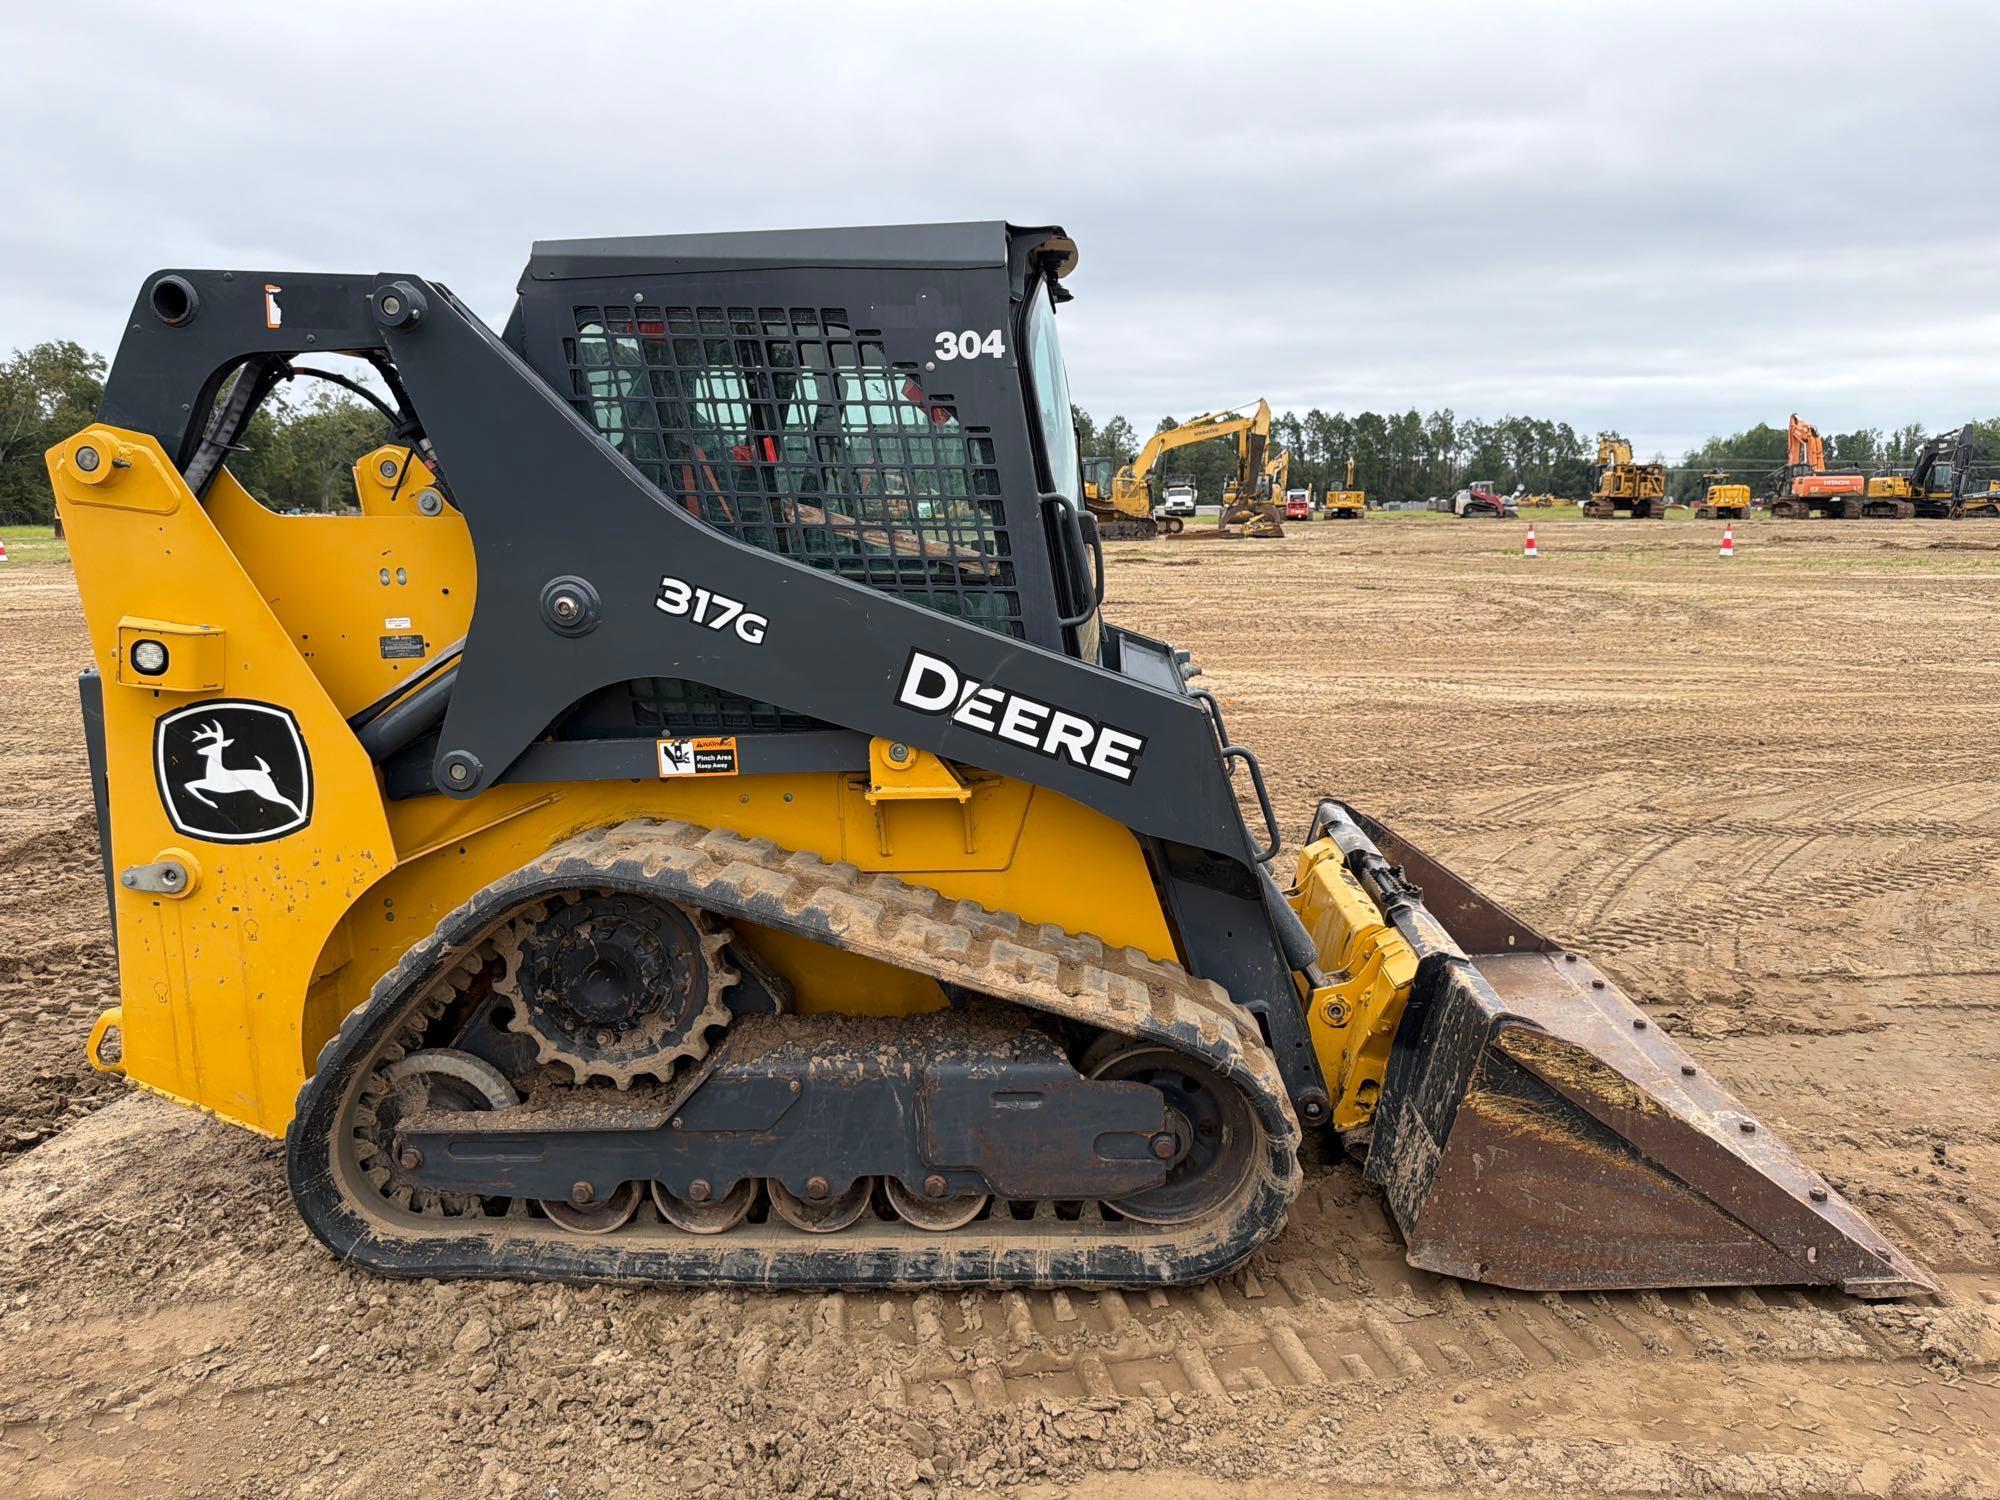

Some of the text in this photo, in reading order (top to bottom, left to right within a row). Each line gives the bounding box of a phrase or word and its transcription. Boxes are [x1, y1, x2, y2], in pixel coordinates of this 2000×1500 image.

[934, 329, 1006, 361] 304
[655, 577, 768, 644] 317G
[899, 652, 1143, 780] DEERE
